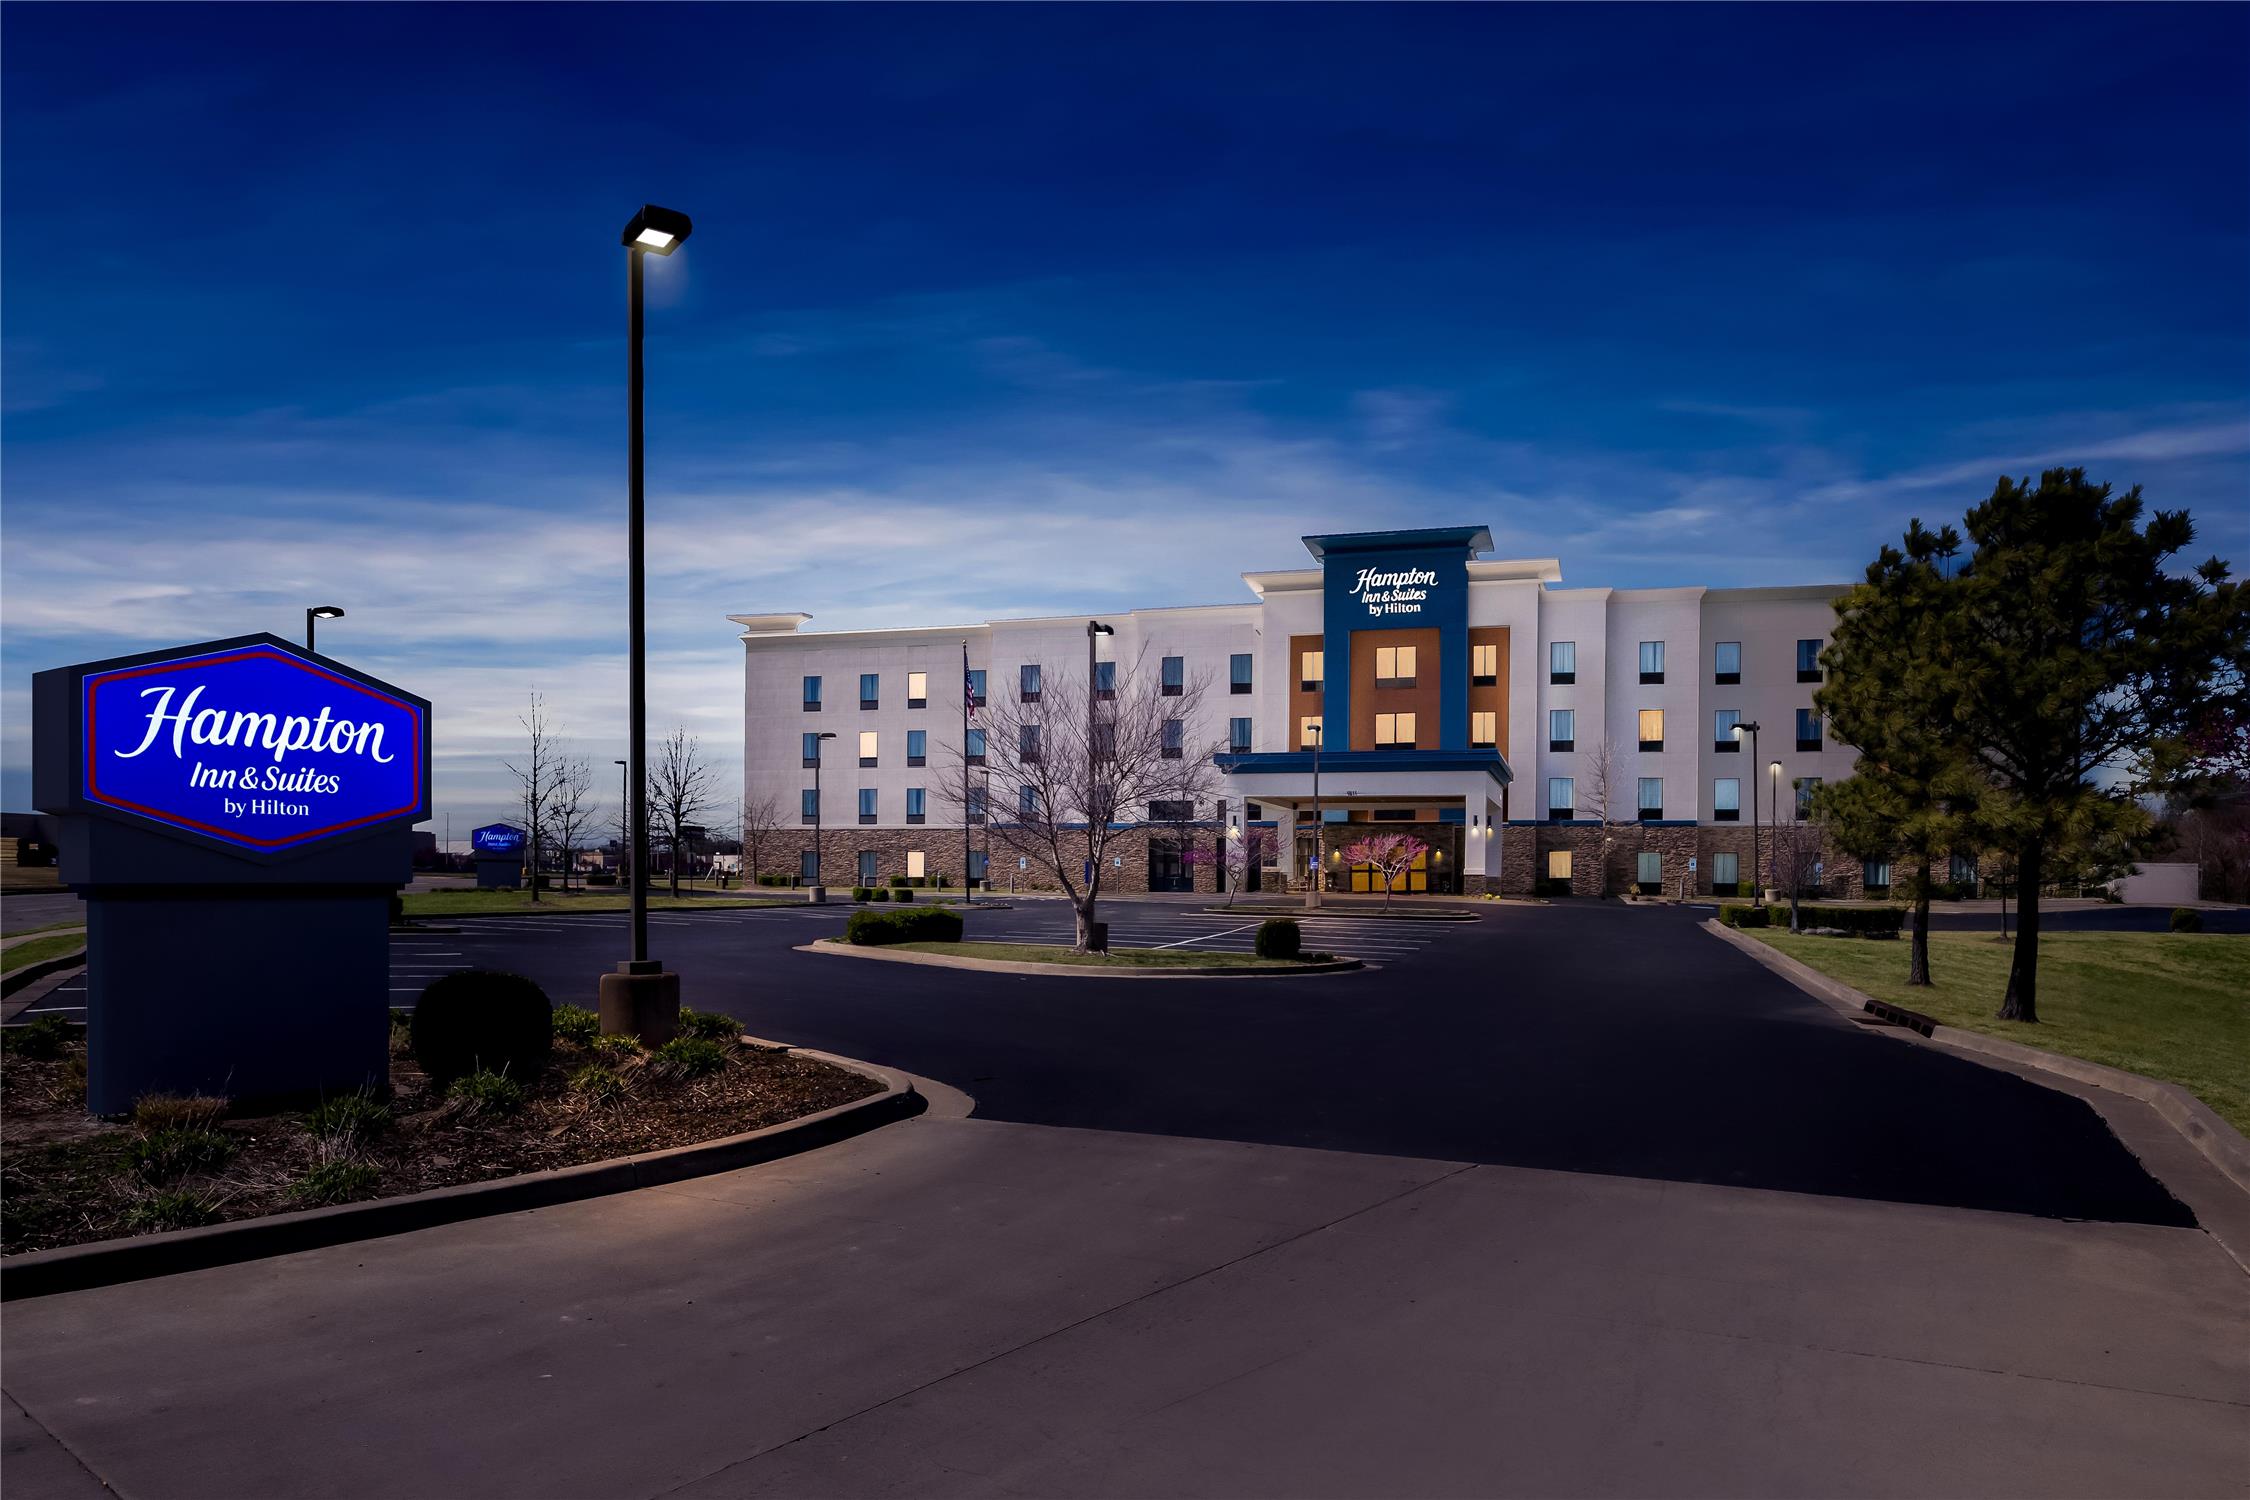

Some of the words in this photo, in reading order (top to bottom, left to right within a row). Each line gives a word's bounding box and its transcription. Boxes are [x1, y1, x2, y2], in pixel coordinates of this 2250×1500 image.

[1349, 566, 1439, 594] Hampton
[1361, 591, 1381, 603] Inn
[1391, 587, 1427, 602] Suites
[1369, 603, 1383, 617] by
[1385, 603, 1421, 614] Hilton
[114, 685, 395, 764] Hampton
[190, 761, 237, 789] Inn
[261, 765, 341, 794] Suites
[224, 797, 247, 818] by
[251, 799, 310, 816] Hilton
[477, 831, 520, 842] Hampton
